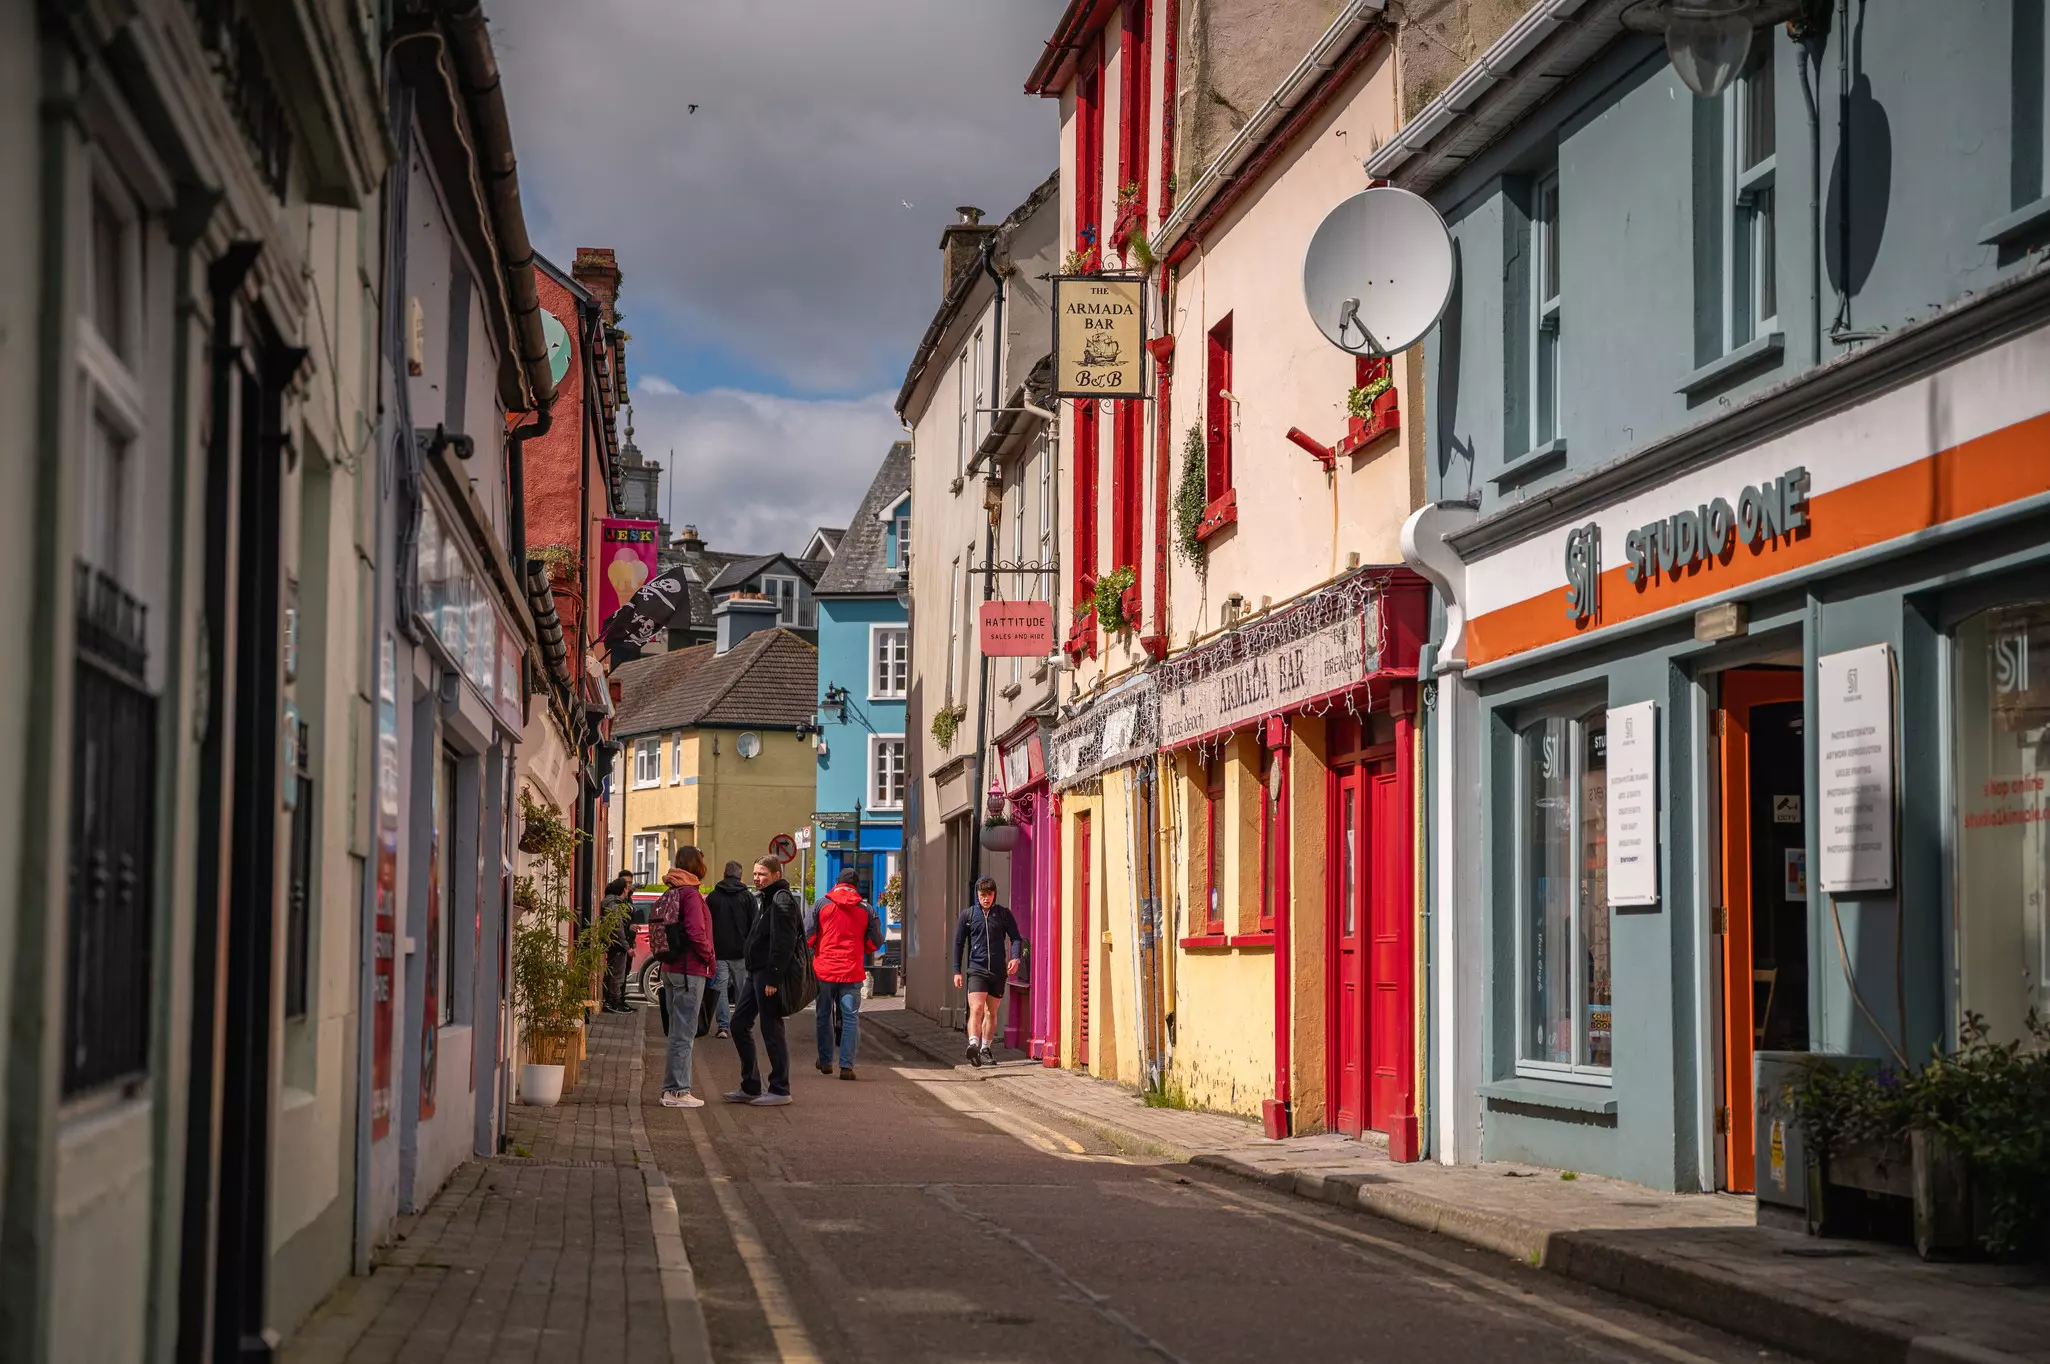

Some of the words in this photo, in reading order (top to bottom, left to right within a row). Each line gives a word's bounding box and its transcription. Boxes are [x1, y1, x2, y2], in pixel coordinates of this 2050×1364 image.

[1090, 287, 1109, 296] THE
[1066, 303, 1134, 315] ARMADA
[1085, 318, 1114, 330] BAR
[1625, 496, 1730, 584] STUDIO
[1737, 466, 1806, 545] ONE
[985, 617, 1046, 627] HATTITUDE
[1219, 659, 1270, 714] ARMADA
[1279, 648, 1305, 693] BAR
[2011, 773, 2045, 794] online
